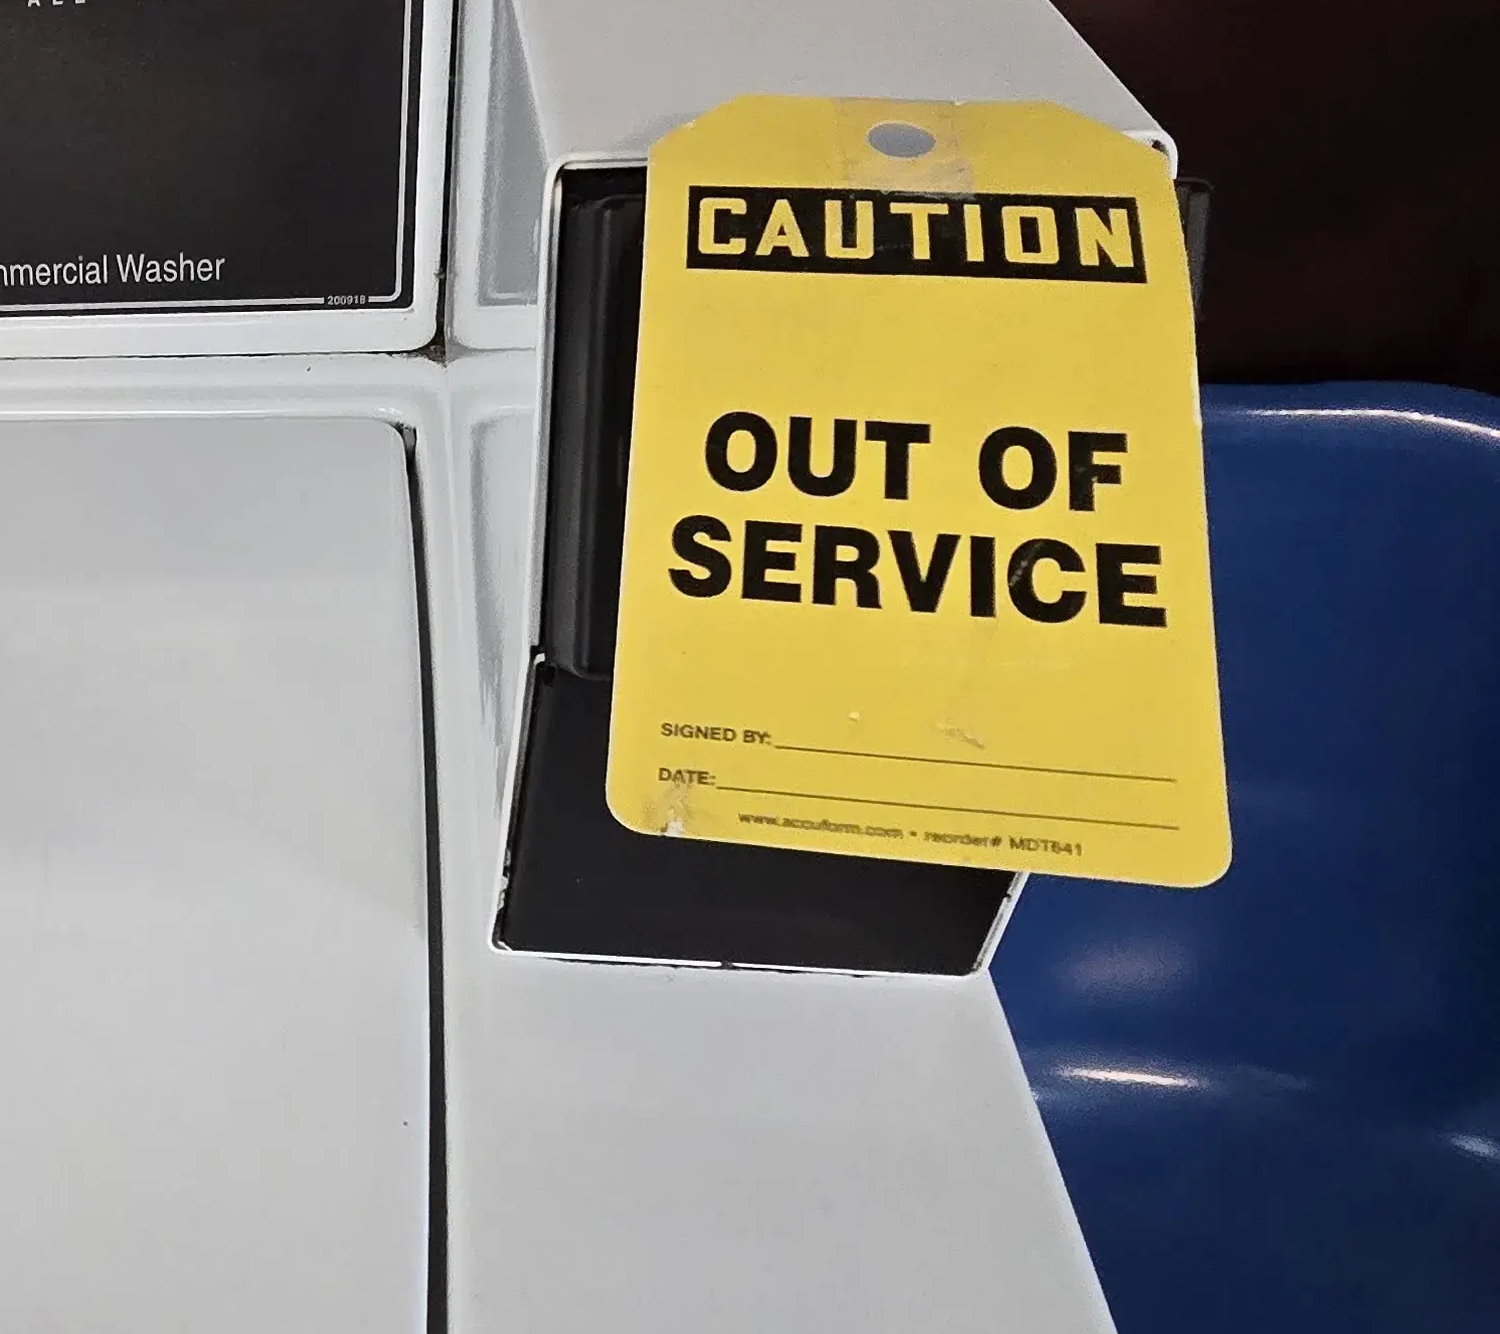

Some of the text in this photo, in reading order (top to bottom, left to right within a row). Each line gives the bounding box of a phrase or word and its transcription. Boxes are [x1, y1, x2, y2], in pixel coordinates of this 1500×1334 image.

[698, 196, 1134, 267] CAUTION
[116, 252, 226, 283] Washer
[704, 411, 1128, 513] OUT OF
[668, 515, 1168, 629] SERVICE
[660, 722, 773, 745] SIGNED BY:
[658, 767, 717, 786] DATE:
